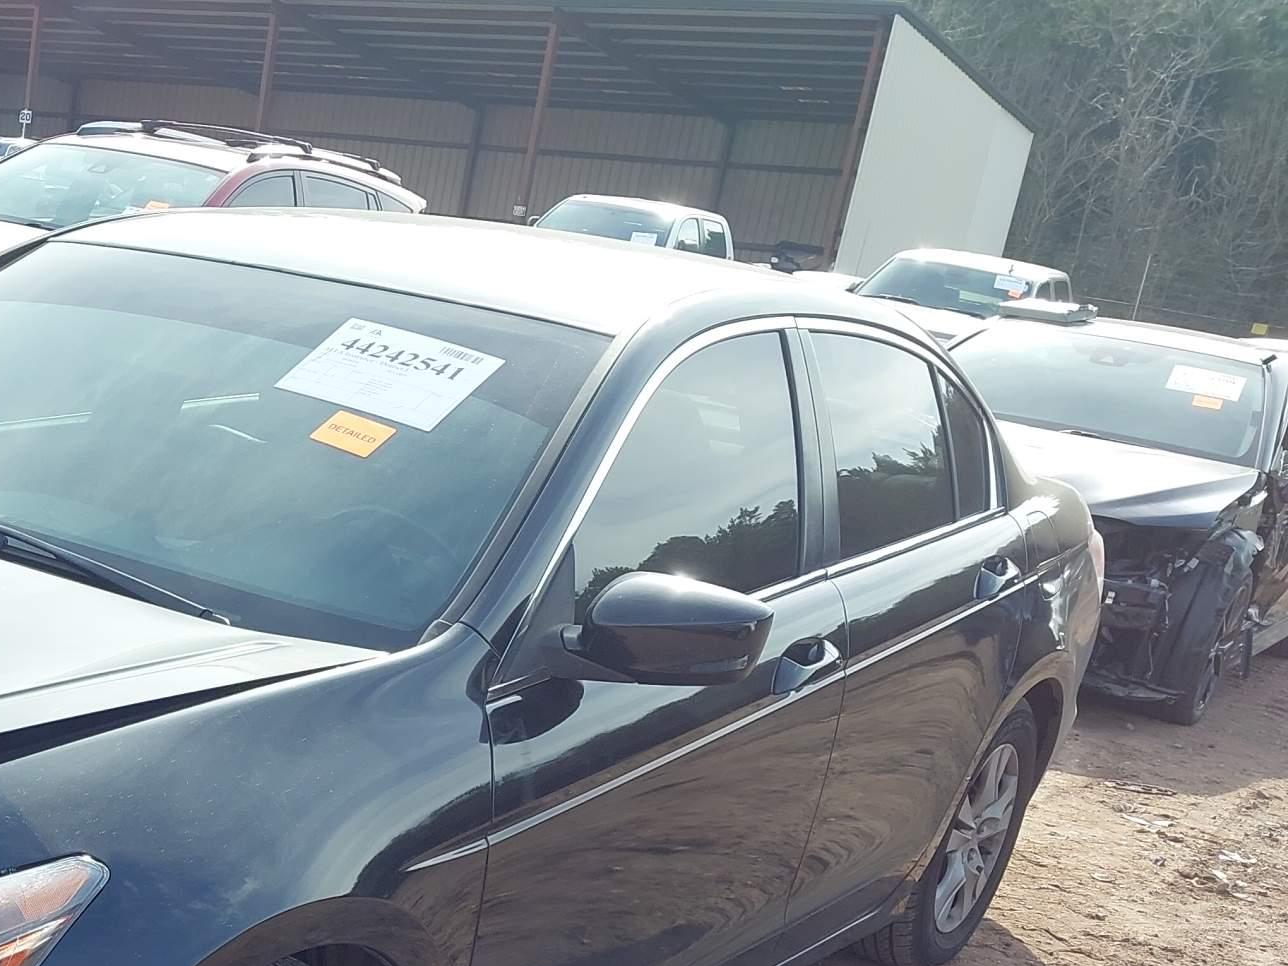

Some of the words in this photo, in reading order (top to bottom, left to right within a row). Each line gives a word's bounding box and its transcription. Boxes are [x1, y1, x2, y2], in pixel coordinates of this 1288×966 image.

[20, 111, 31, 121] 20
[341, 338, 465, 380] 44242541
[328, 423, 377, 444] DETAILED
